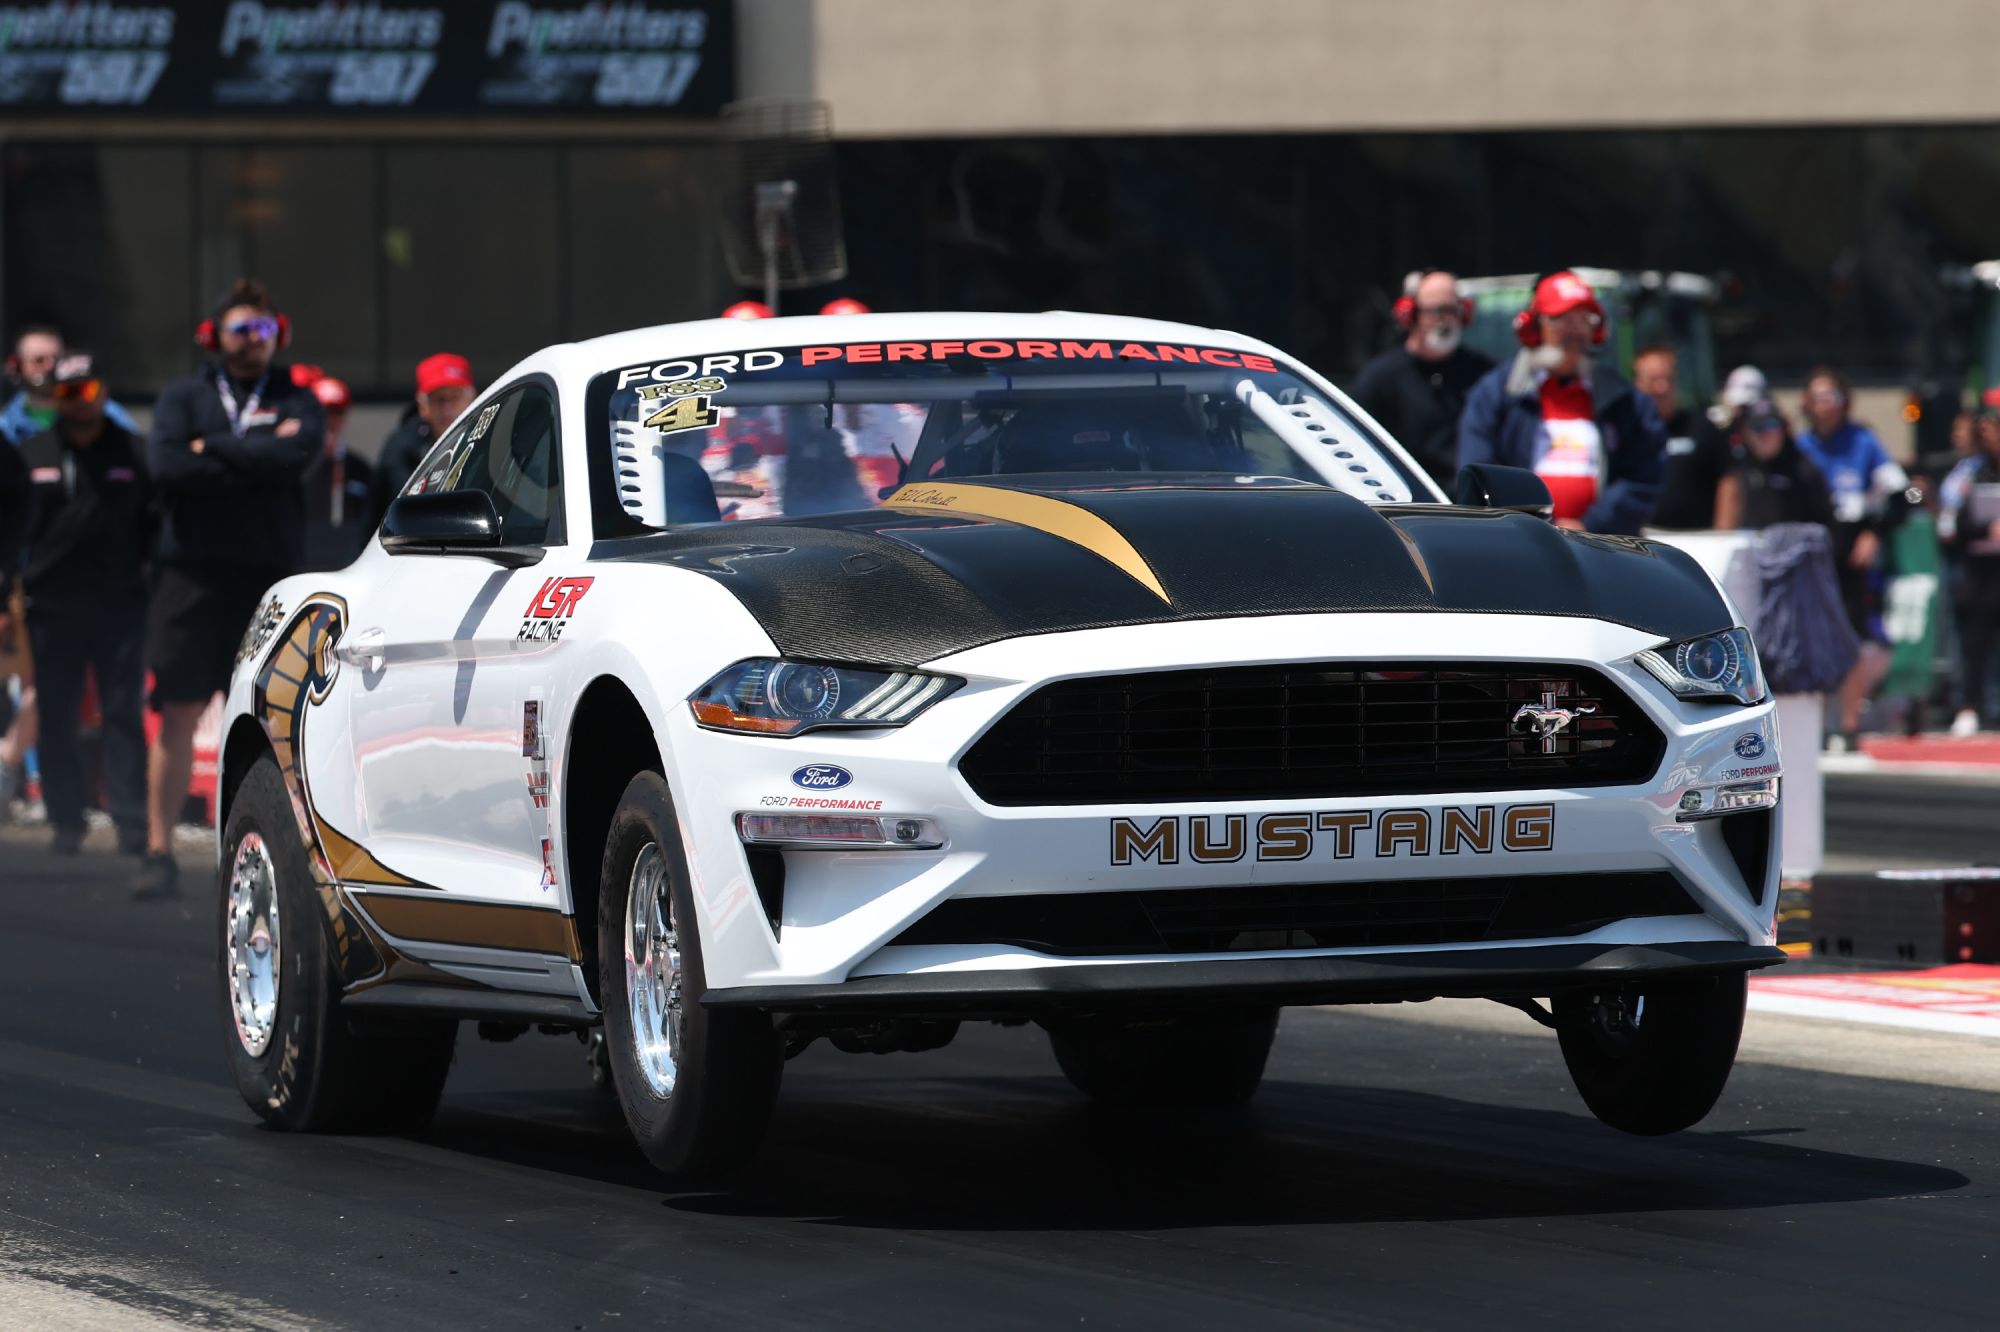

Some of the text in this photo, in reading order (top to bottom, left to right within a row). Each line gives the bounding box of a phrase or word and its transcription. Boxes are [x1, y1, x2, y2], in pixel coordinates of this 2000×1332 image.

[617, 340, 1278, 390] FORD PERFORMANCE
[643, 395, 721, 435] 4
[523, 576, 595, 618] KSR
[516, 621, 566, 642] RACING
[1721, 769, 1740, 779] FORD
[760, 796, 882, 810] FORD PERFORMANCE
[1110, 803, 1555, 866] MUSTANG
